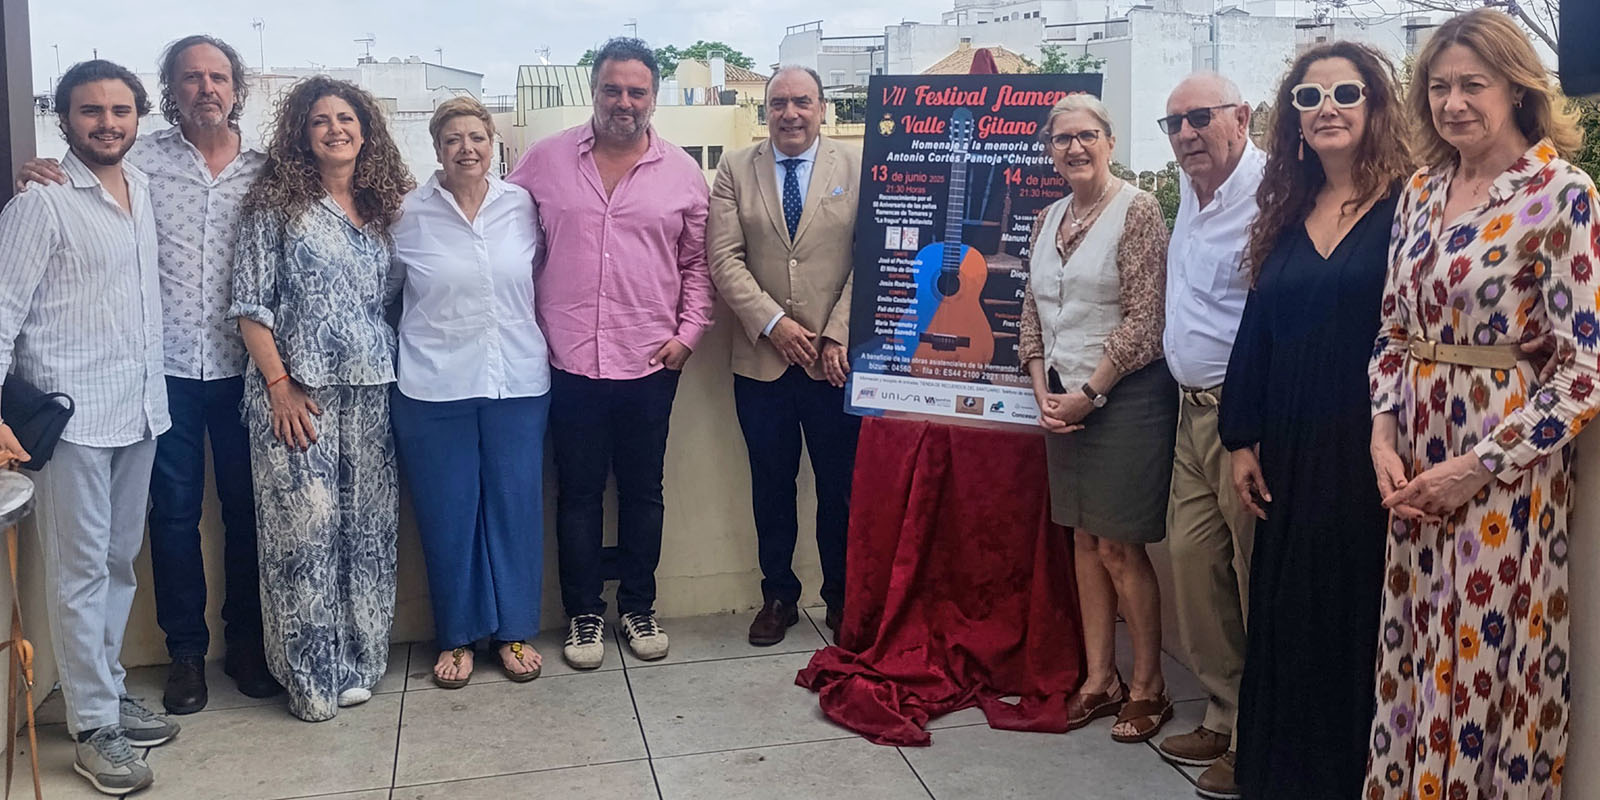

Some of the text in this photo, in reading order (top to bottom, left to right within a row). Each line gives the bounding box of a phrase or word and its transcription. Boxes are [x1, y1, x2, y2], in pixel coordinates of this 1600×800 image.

[882, 86, 907, 106] VII
[914, 85, 988, 106] Festival
[901, 115, 1038, 139] Valle Gitano
[912, 140, 1045, 152] Homenaje a la memoria de
[886, 152, 925, 162] Antonio
[928, 152, 960, 162] Cortés
[964, 153, 1000, 165] Pantoja
[872, 164, 888, 181] 13
[892, 172, 903, 182] de
[904, 171, 927, 184] junio
[1003, 168, 1065, 188] 14 de junio
[886, 184, 926, 194] 21:30 Horas
[1019, 188, 1064, 198] 21:30 Horas
[1001, 233, 1028, 242] Manuel
[930, 358, 966, 368] asistenciales
[984, 363, 1019, 372] Hermandad
[962, 370, 980, 379] 2100
